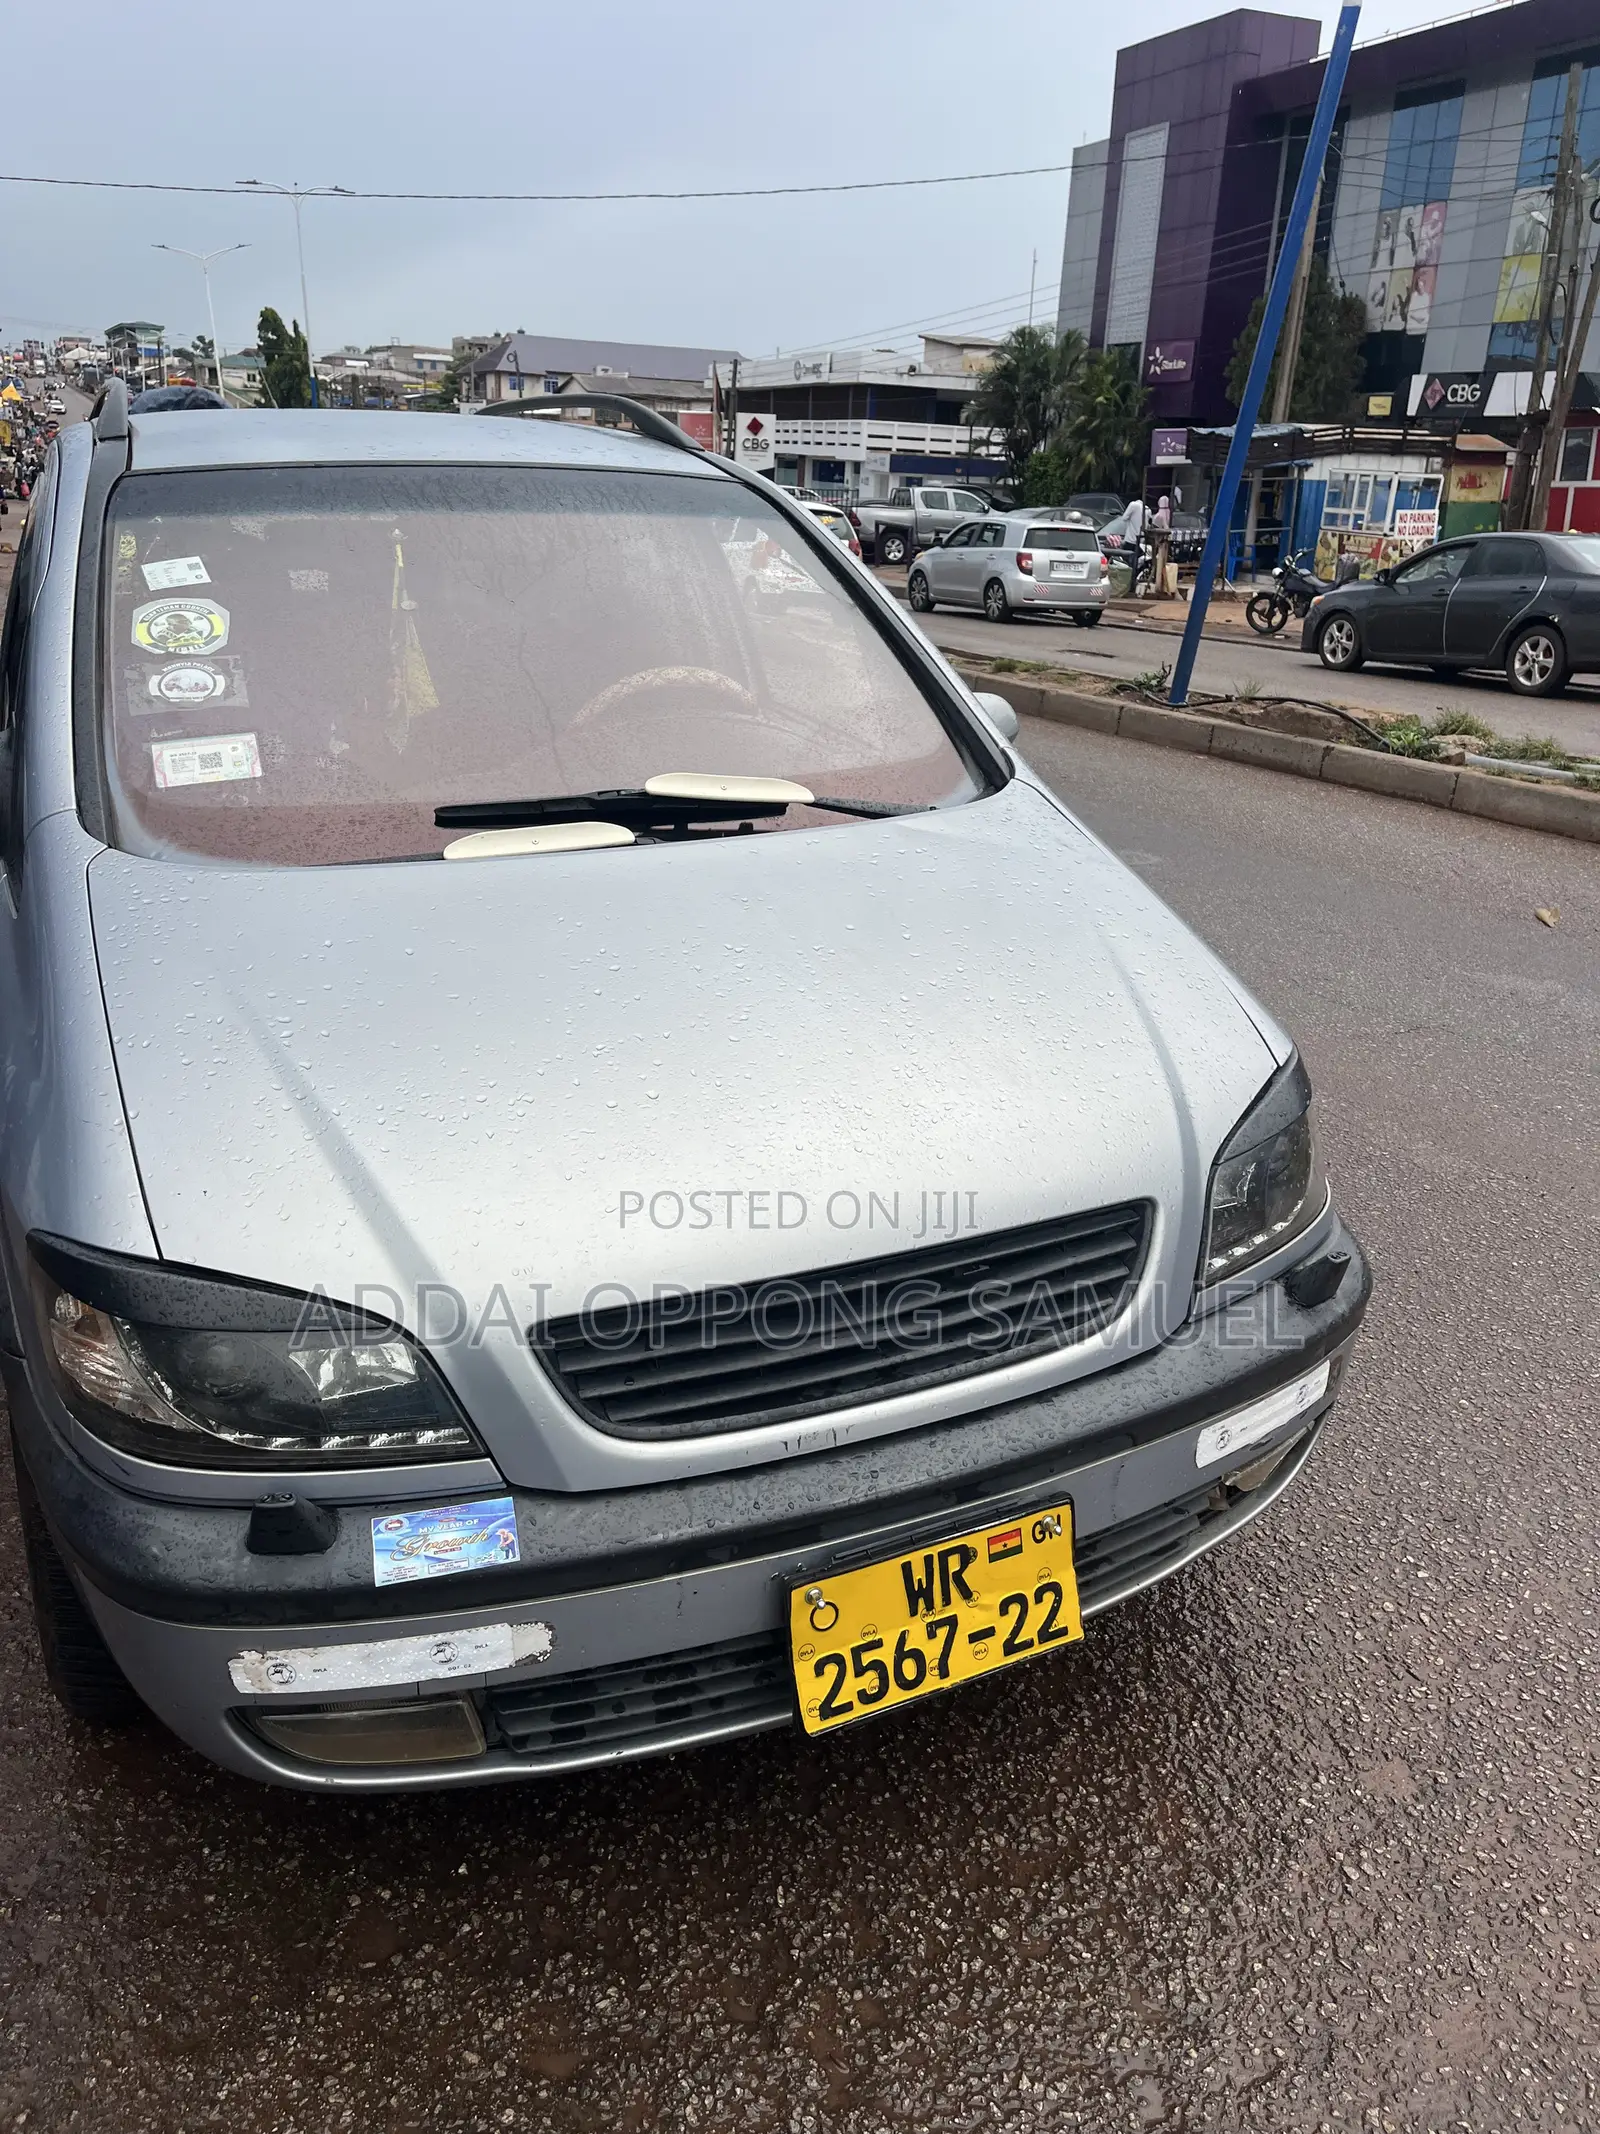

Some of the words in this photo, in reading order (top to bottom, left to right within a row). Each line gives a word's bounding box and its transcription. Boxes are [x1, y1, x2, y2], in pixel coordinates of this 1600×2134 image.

[1446, 383, 1481, 403] CBG
[742, 437, 770, 450] CBG
[1398, 512, 1408, 523] NO
[1409, 512, 1436, 524] PARKING
[1397, 525, 1407, 536] NO
[1408, 525, 1435, 537] LOADING
[418, 1526, 435, 1534] MY
[438, 1520, 464, 1531] YEAR
[464, 1519, 479, 1527] OF
[389, 1527, 490, 1562] Growth
[900, 1543, 974, 1618] WR
[862, 1628, 876, 1638] DVLA
[799, 1648, 814, 1657] DVLA
[813, 1581, 1069, 1721] 2567-22
[974, 1648, 988, 1656] DVLA
